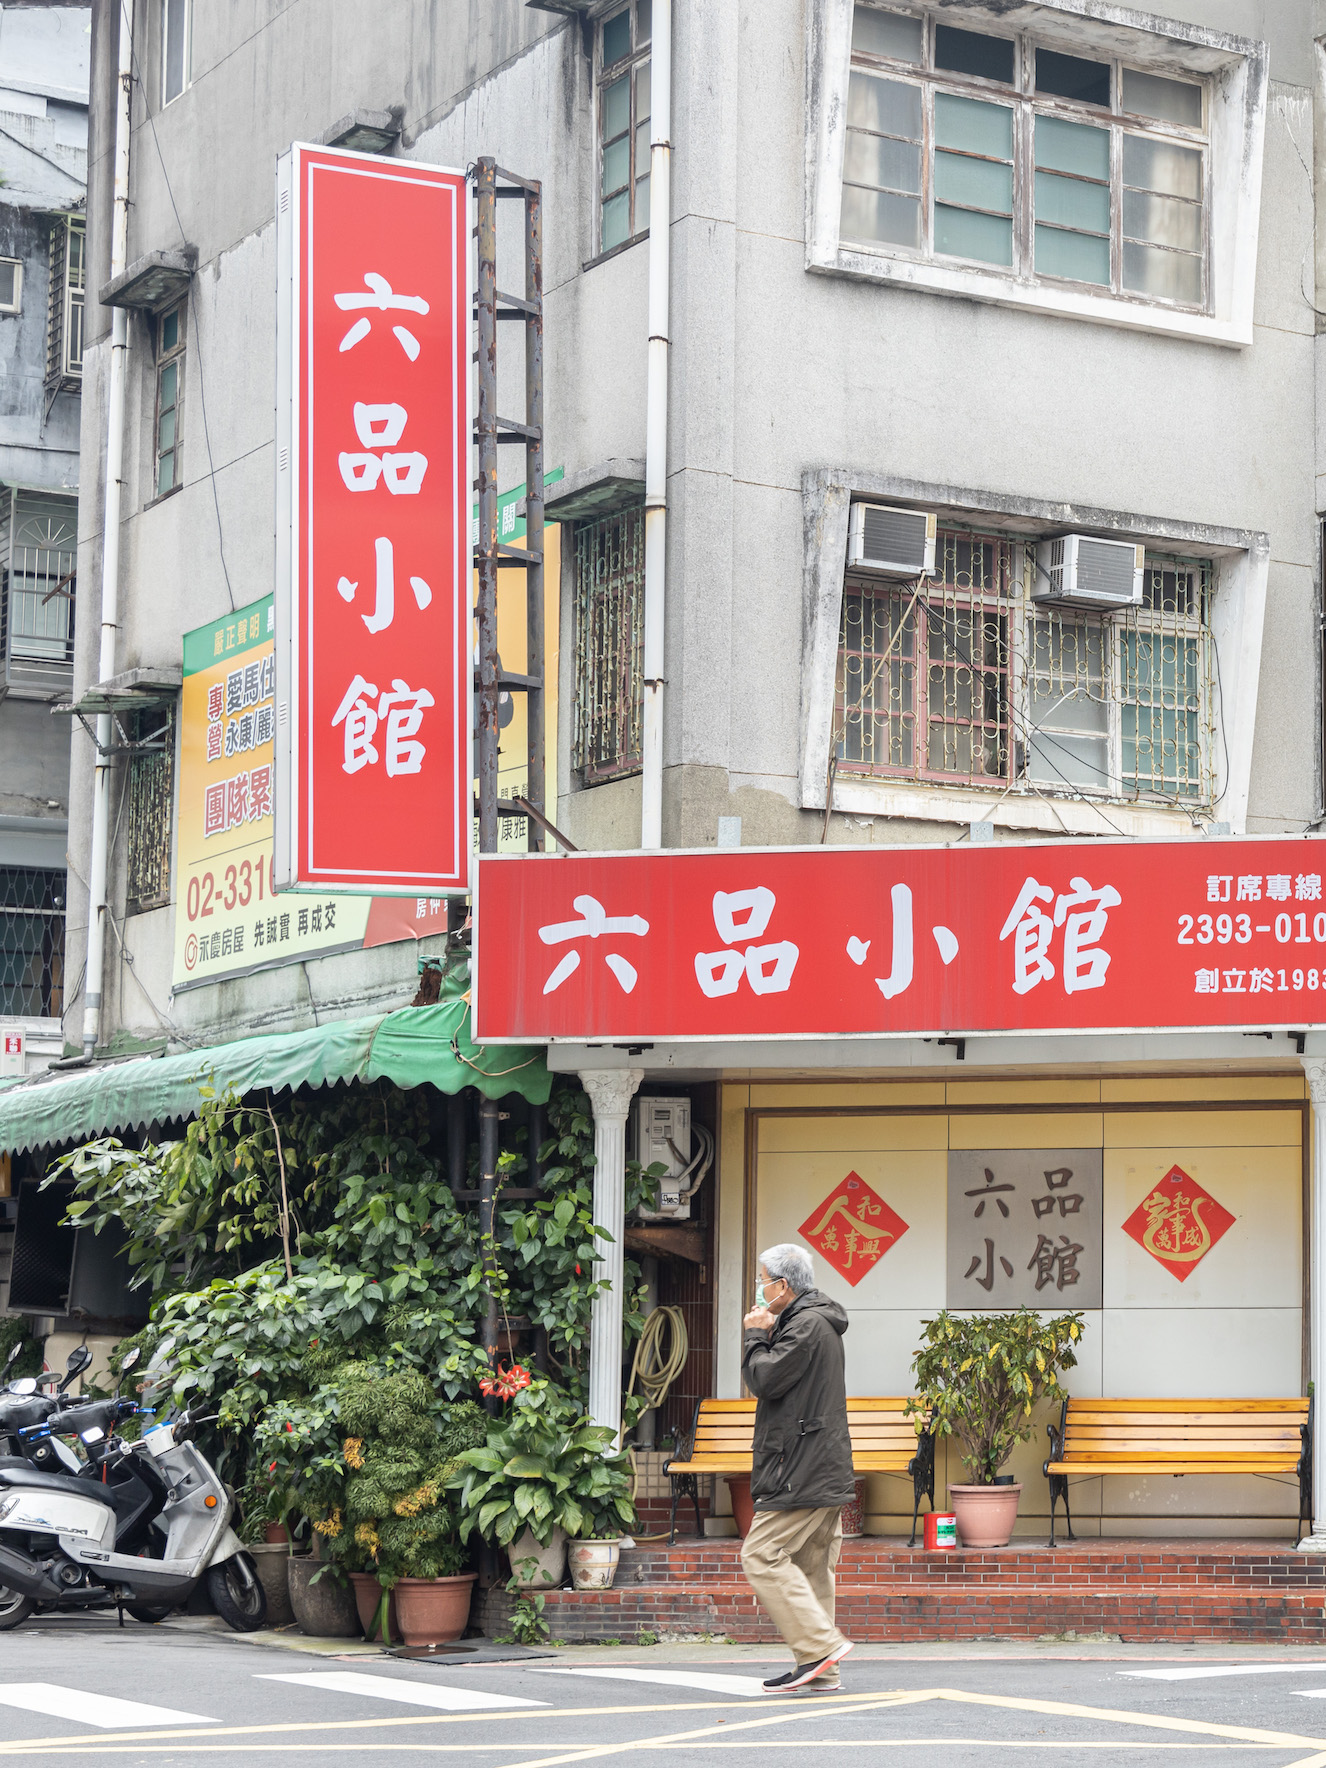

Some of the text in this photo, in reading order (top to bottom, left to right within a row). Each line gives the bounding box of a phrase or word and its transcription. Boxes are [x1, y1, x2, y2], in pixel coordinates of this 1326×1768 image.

[331, 272, 435, 778] 六品小館
[213, 612, 260, 656] 嚴正聲明
[226, 653, 274, 715] 愛馬仕
[225, 706, 274, 757] 永康/麗
[204, 763, 274, 838] 團隊累
[1207, 873, 1322, 902] 訂席專線
[199, 902, 336, 962] 永慶房屋 先誠實 再成交
[538, 877, 1121, 999] 六品小館
[964, 1168, 1084, 1219] 六品
[964, 1235, 1084, 1291] 小館
